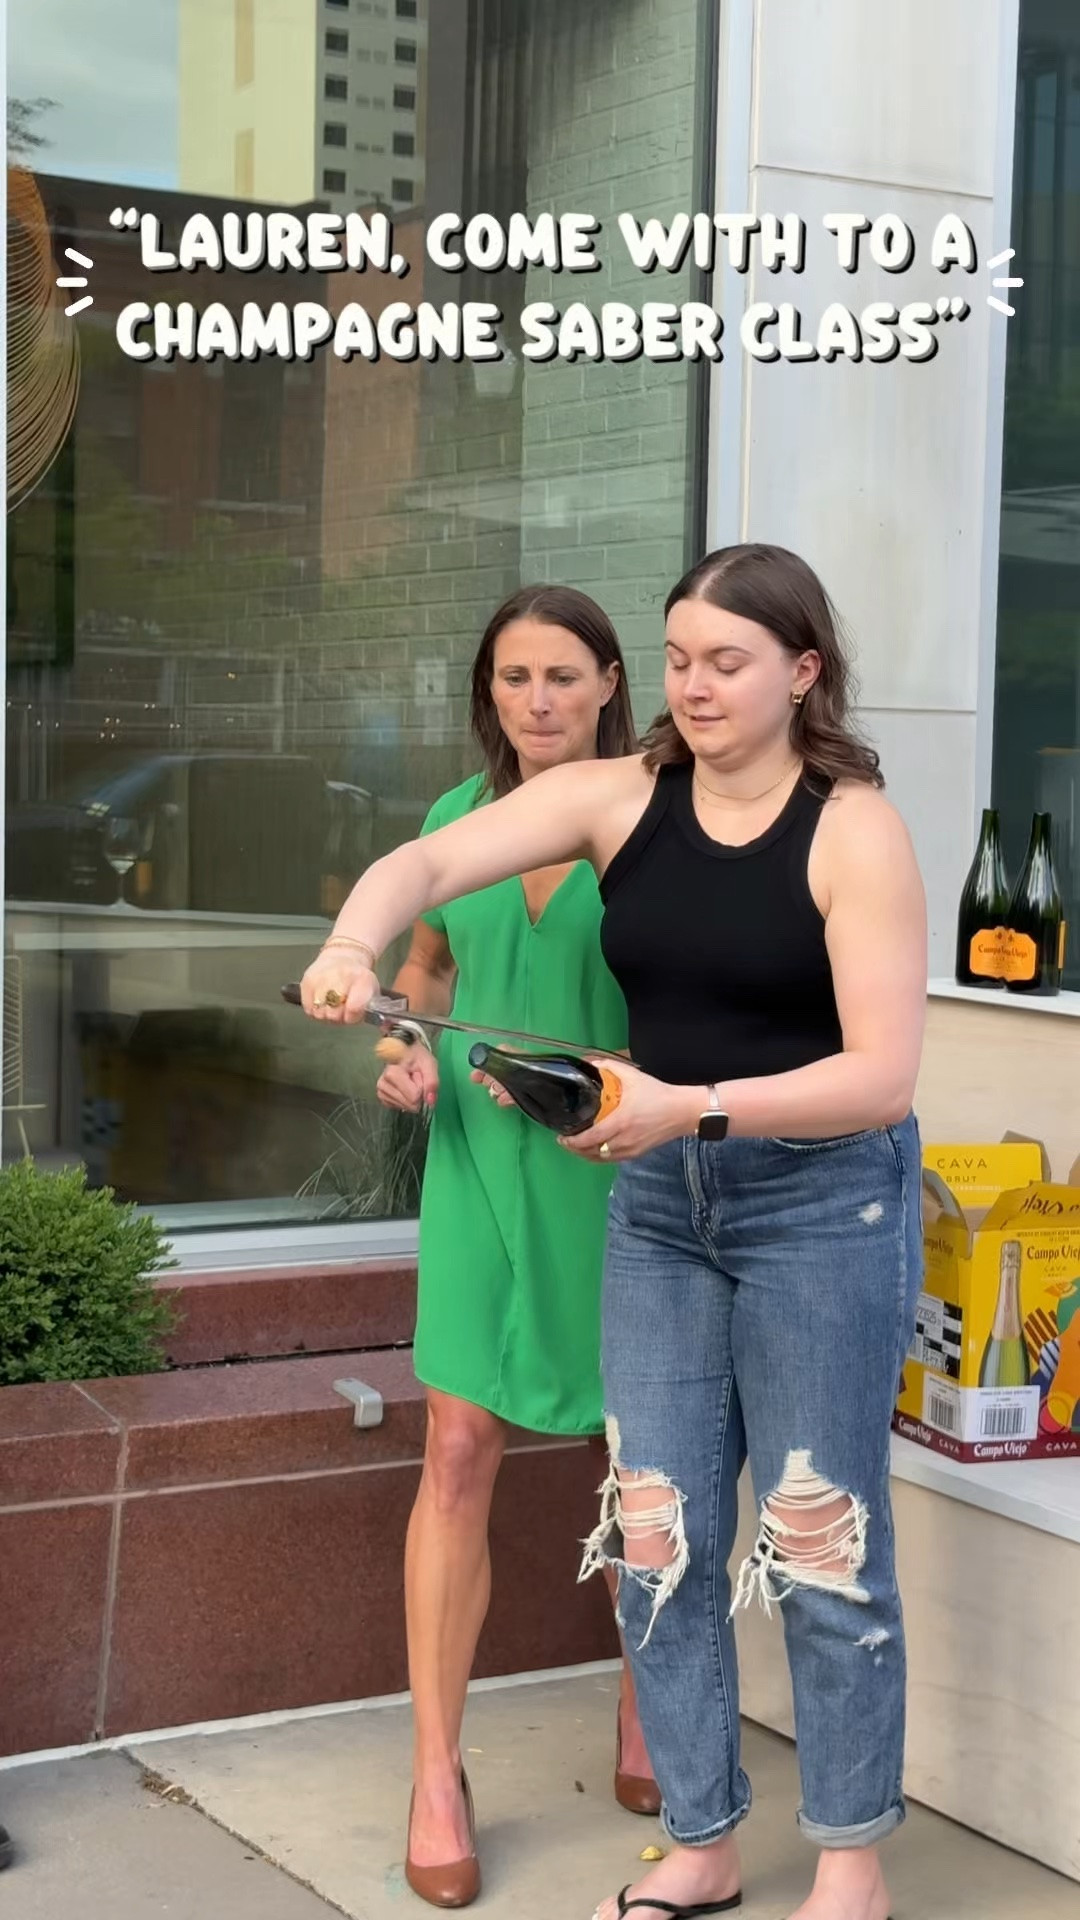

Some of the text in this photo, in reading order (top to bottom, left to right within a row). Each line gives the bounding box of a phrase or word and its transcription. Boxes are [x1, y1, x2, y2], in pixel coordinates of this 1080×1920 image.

[936, 1158, 988, 1169] CAVA
[946, 1175, 977, 1183] BRUT
[1026, 1245, 1060, 1263] Campo
[899, 1417, 916, 1436] Campo
[938, 1438, 960, 1454] CAVA
[973, 1441, 1078, 1460] Campo Viejo CAVA
